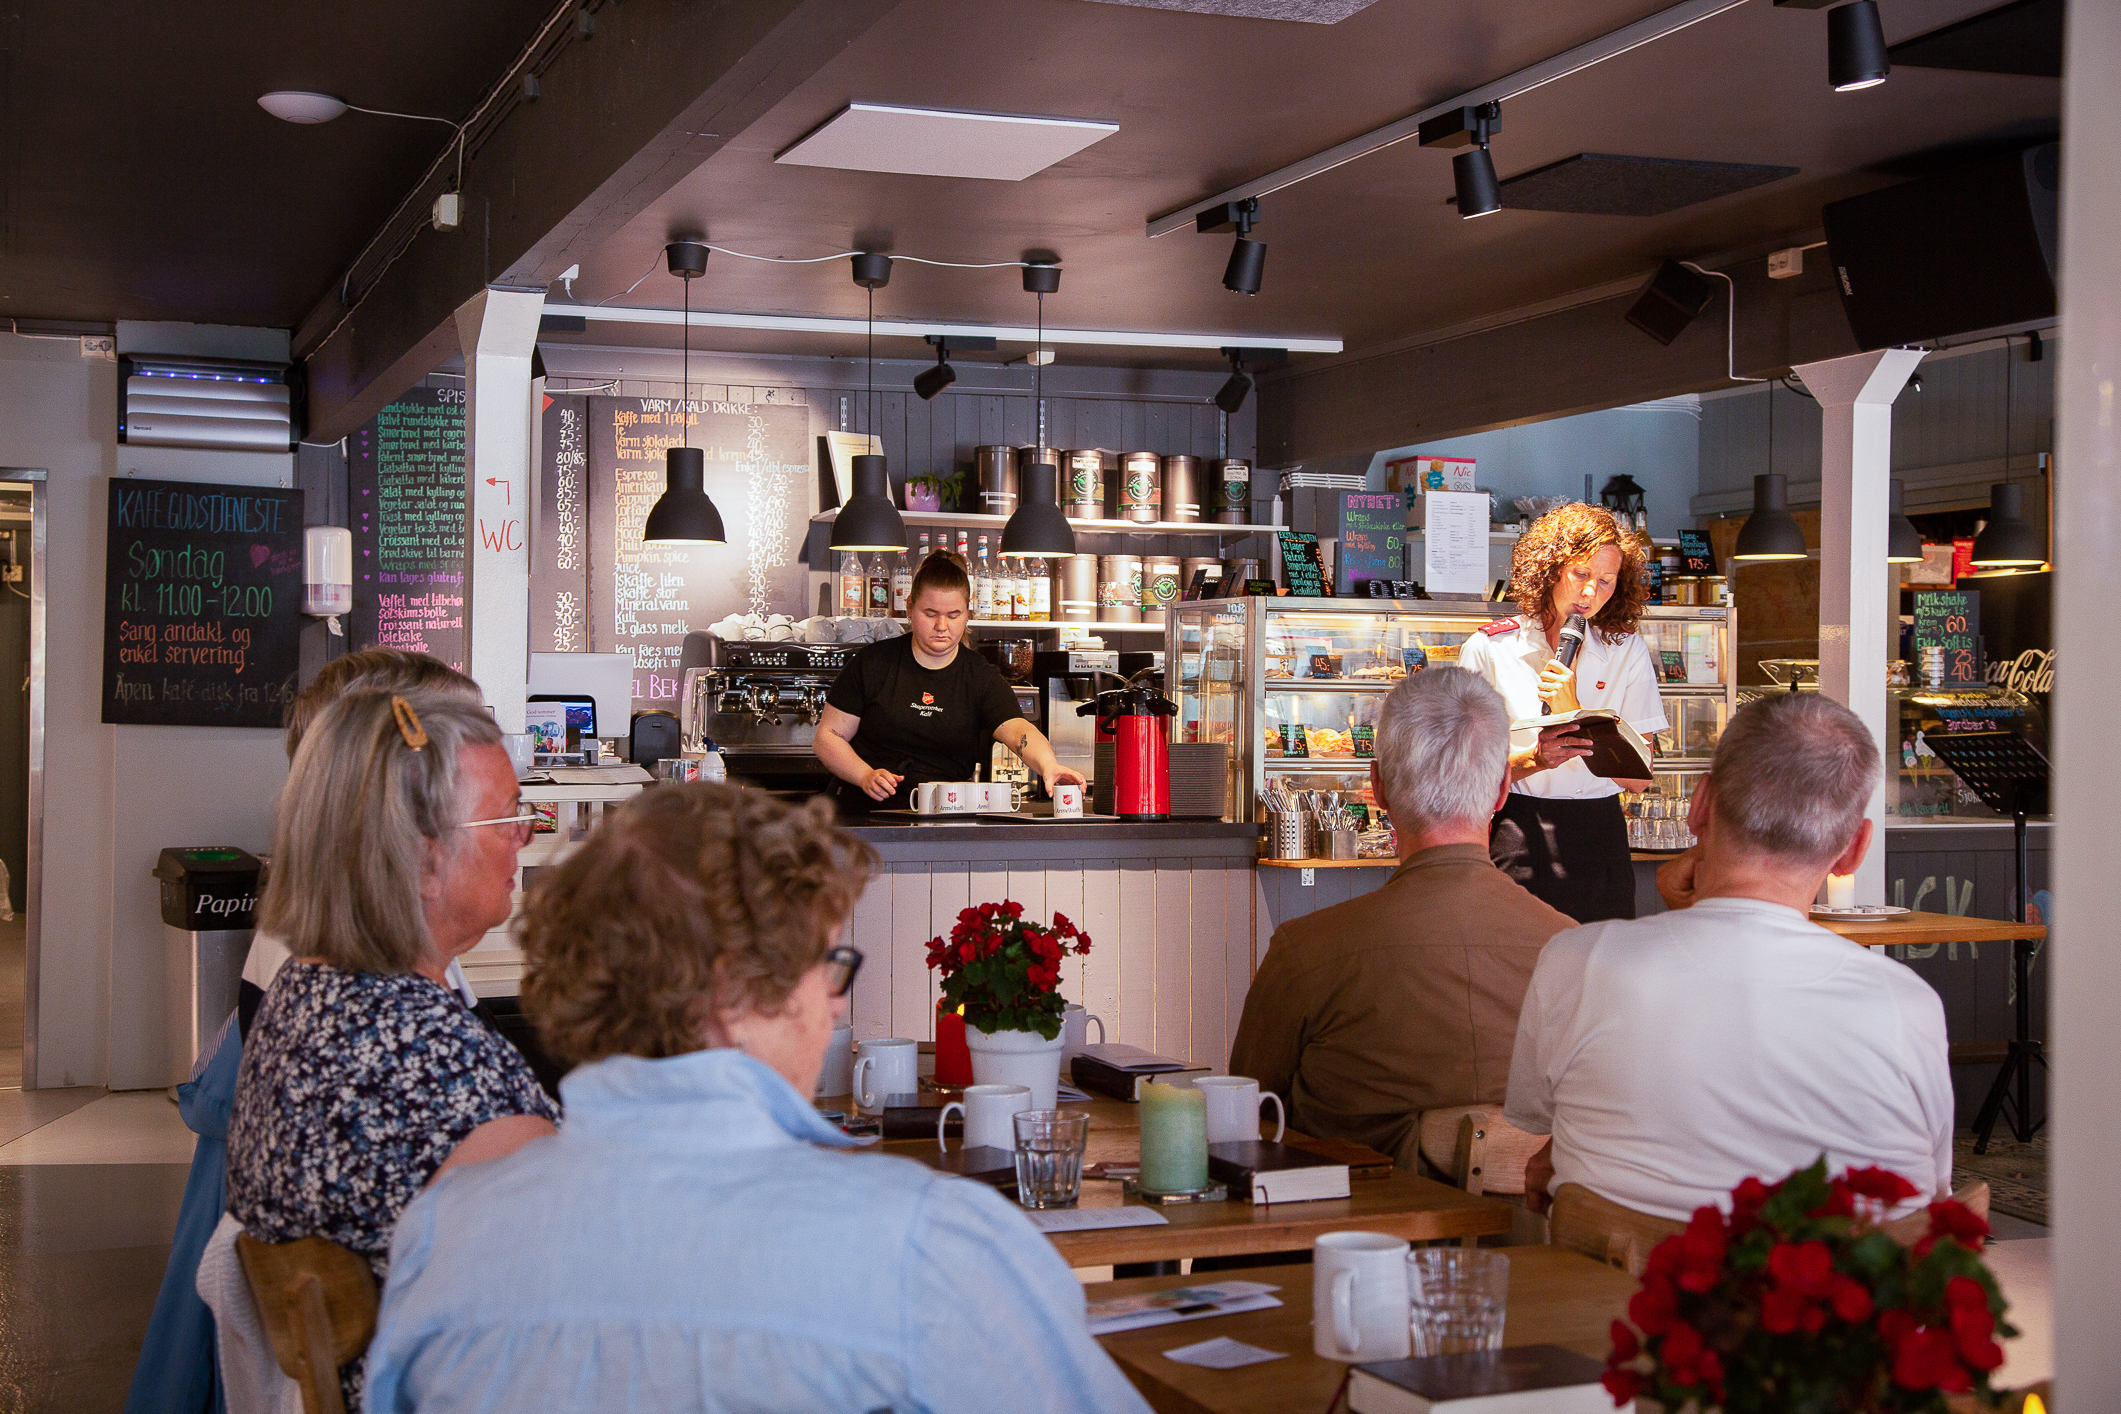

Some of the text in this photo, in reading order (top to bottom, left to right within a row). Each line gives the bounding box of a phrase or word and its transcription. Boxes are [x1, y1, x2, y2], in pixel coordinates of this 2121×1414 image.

[427, 405, 440, 415] med
[640, 399, 672, 412] VARM
[402, 414, 449, 427] rundstykke
[614, 409, 639, 427] Kaffe
[641, 412, 661, 424] med
[424, 427, 441, 438] med
[613, 423, 626, 436] Te
[423, 439, 440, 449] med
[615, 435, 640, 447] Varm
[616, 446, 642, 459] Varm
[378, 462, 436, 474] Ciabatta med
[1453, 466, 1471, 478] Nic
[378, 474, 435, 486] Ciabatta med
[615, 468, 658, 482] Espresso
[405, 487, 423, 497] med
[426, 486, 455, 499] kylling
[378, 498, 413, 511] Vegetar
[414, 498, 437, 510] salat
[439, 501, 448, 511] og
[379, 511, 402, 523] Toast
[404, 511, 422, 521] med
[425, 511, 453, 524] kylling
[615, 515, 643, 528] Latte
[1346, 511, 1370, 522] Wraps
[379, 523, 413, 536] Vegetar
[439, 523, 456, 533] med
[480, 519, 522, 552] WC
[379, 534, 420, 547] Croissant
[422, 534, 440, 546] med
[1345, 531, 1368, 544] Wraps
[615, 539, 639, 551] Chili
[379, 547, 437, 559] Brødskive til
[614, 550, 689, 566] Pumpkin spice
[129, 540, 225, 589] Søndag
[612, 562, 641, 576] Juice
[400, 571, 424, 585] lages
[615, 573, 686, 587] Iskaffe liten
[615, 586, 679, 600] Iskaffe stor
[1917, 592, 1968, 607] Milkshake
[378, 593, 429, 609] Vaffel med
[614, 598, 689, 612] Mineralvann
[379, 616, 463, 631] Croissant naturell
[614, 611, 637, 624] Kuli
[164, 620, 226, 643] andakt
[232, 627, 251, 650] og
[614, 619, 689, 638] Et glass melk
[379, 630, 423, 643] Ostekake
[120, 643, 159, 664] enkel
[615, 644, 661, 659] Kan fåes
[114, 672, 154, 706] Åpen
[239, 680, 258, 707] fra
[195, 893, 258, 918] Papir
